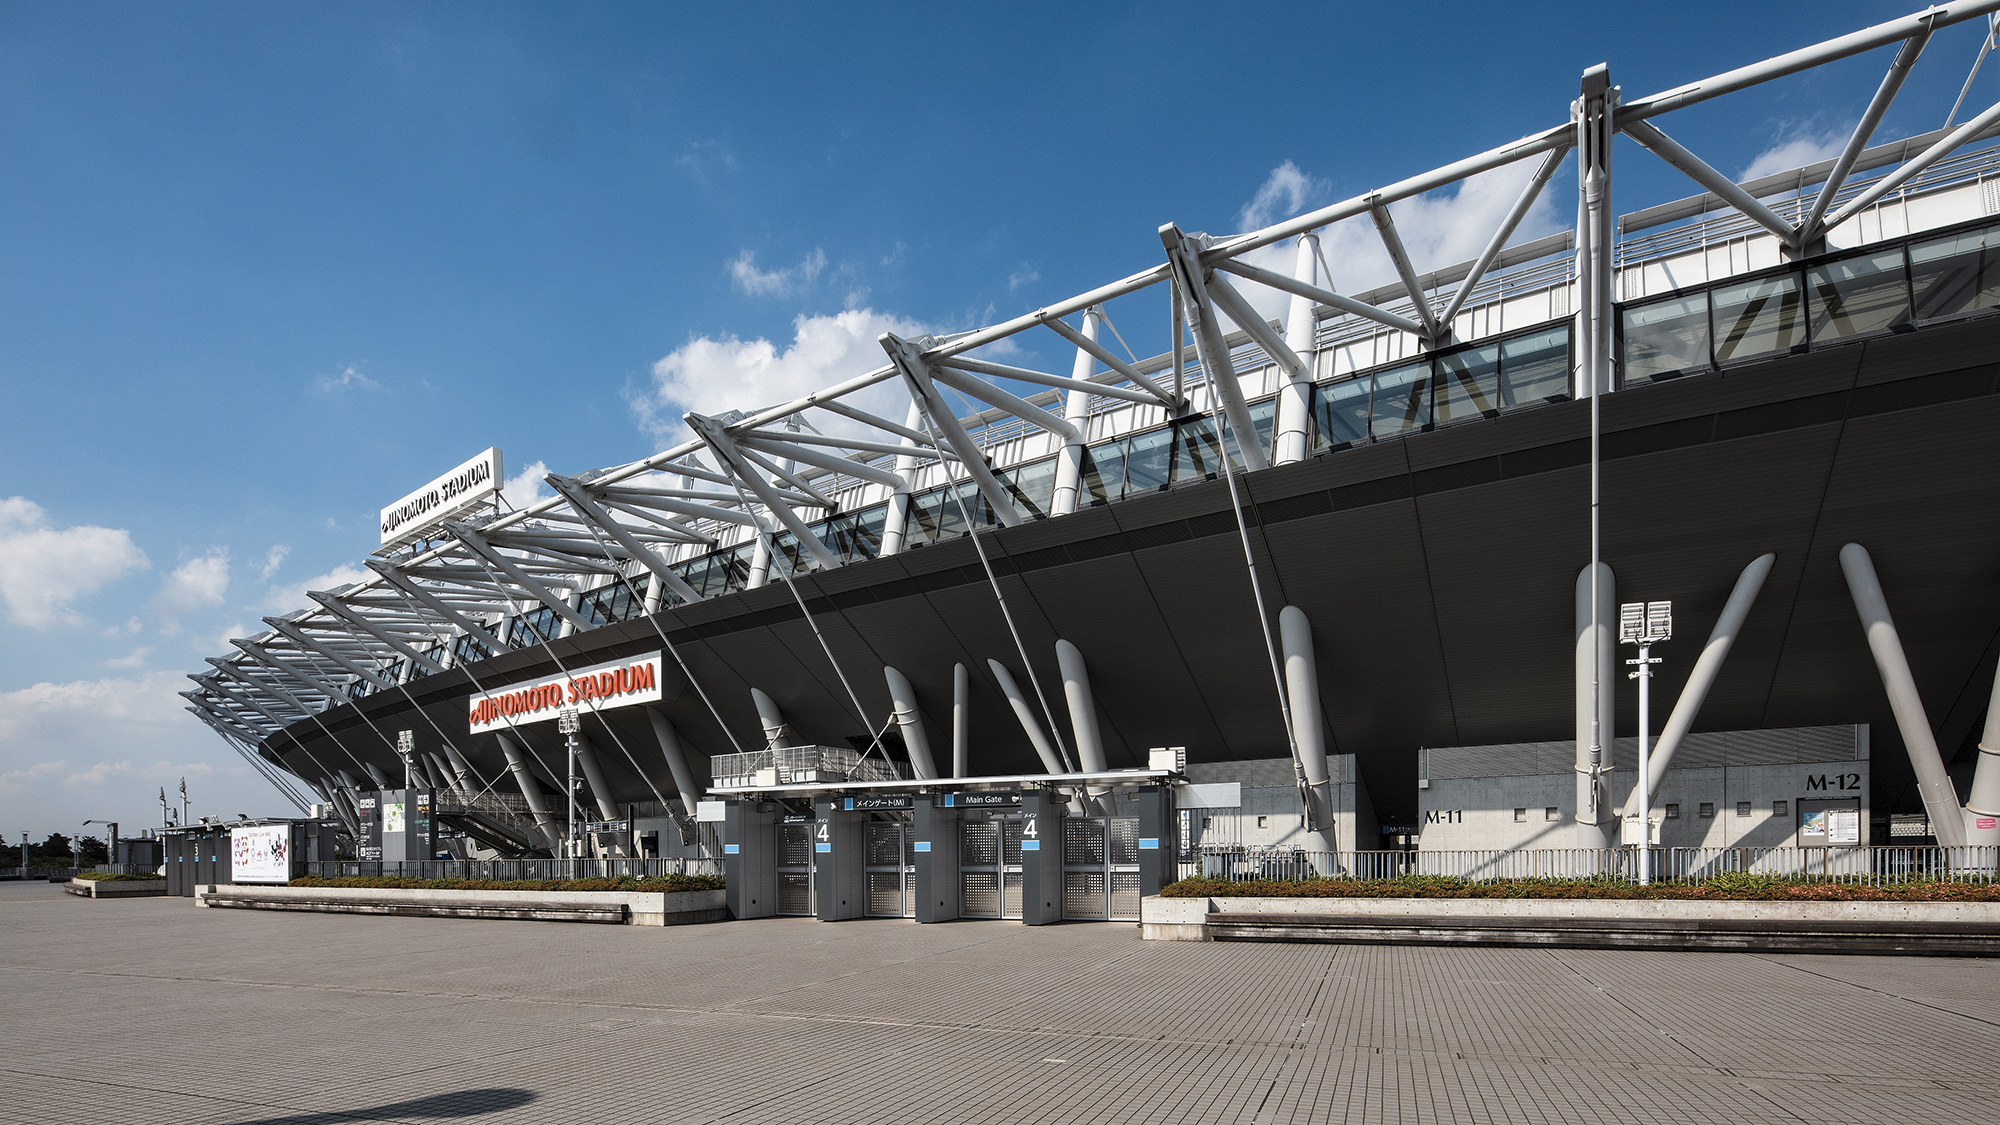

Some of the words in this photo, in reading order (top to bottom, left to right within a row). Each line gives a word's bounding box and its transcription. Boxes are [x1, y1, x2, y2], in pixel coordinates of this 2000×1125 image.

[441, 460, 490, 502] STADIUM
[567, 662, 654, 703] STADIUM
[1806, 773, 1861, 791] M-12
[856, 798, 905, 808] メインゲート(M)
[965, 795, 984, 804] Main
[985, 795, 1003, 804] Gate
[1424, 809, 1462, 824] M-11
[817, 824, 829, 842] 4
[1023, 819, 1037, 839] 4
[194, 846, 199, 856] 3
